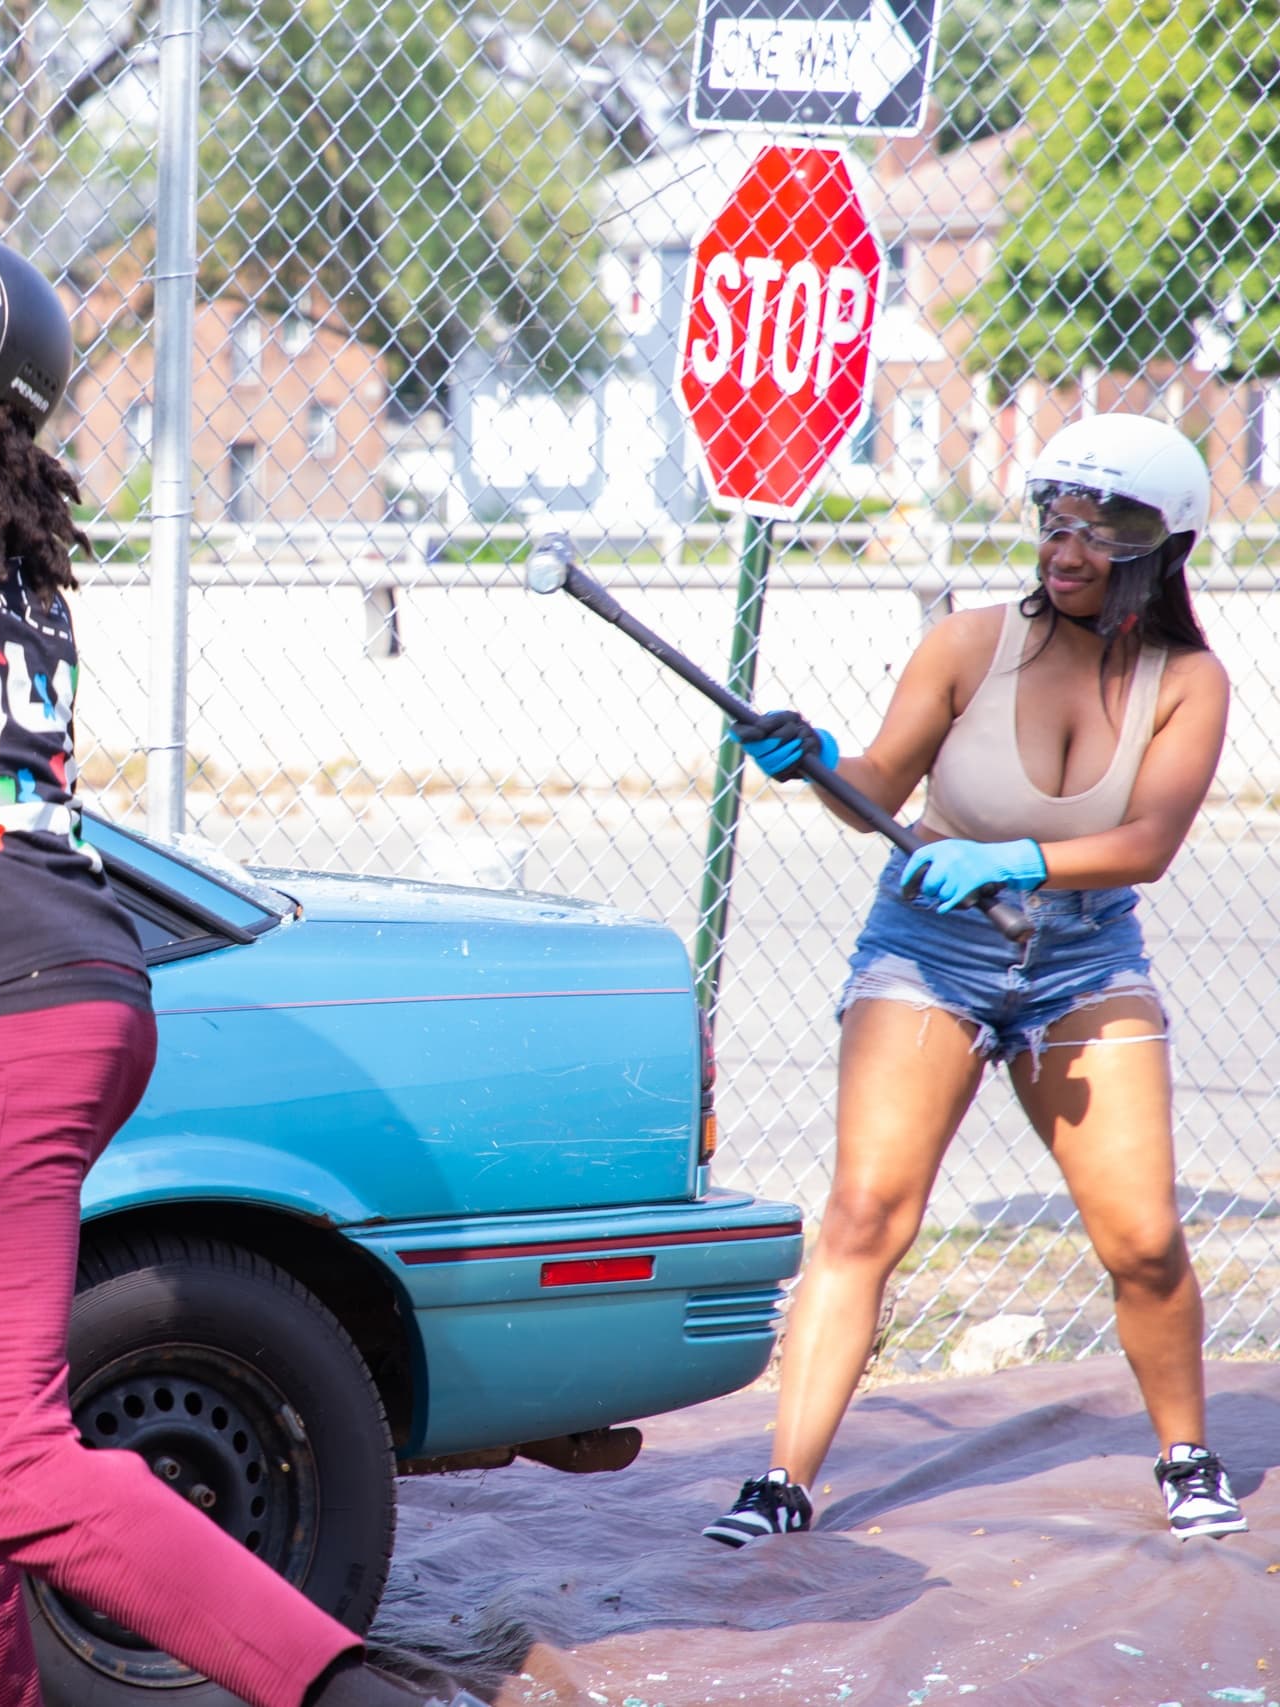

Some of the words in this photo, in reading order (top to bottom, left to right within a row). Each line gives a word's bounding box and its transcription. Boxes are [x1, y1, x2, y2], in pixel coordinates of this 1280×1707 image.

[722, 30, 783, 79] ONE
[795, 32, 861, 80] WAY
[691, 252, 865, 398] STOP
